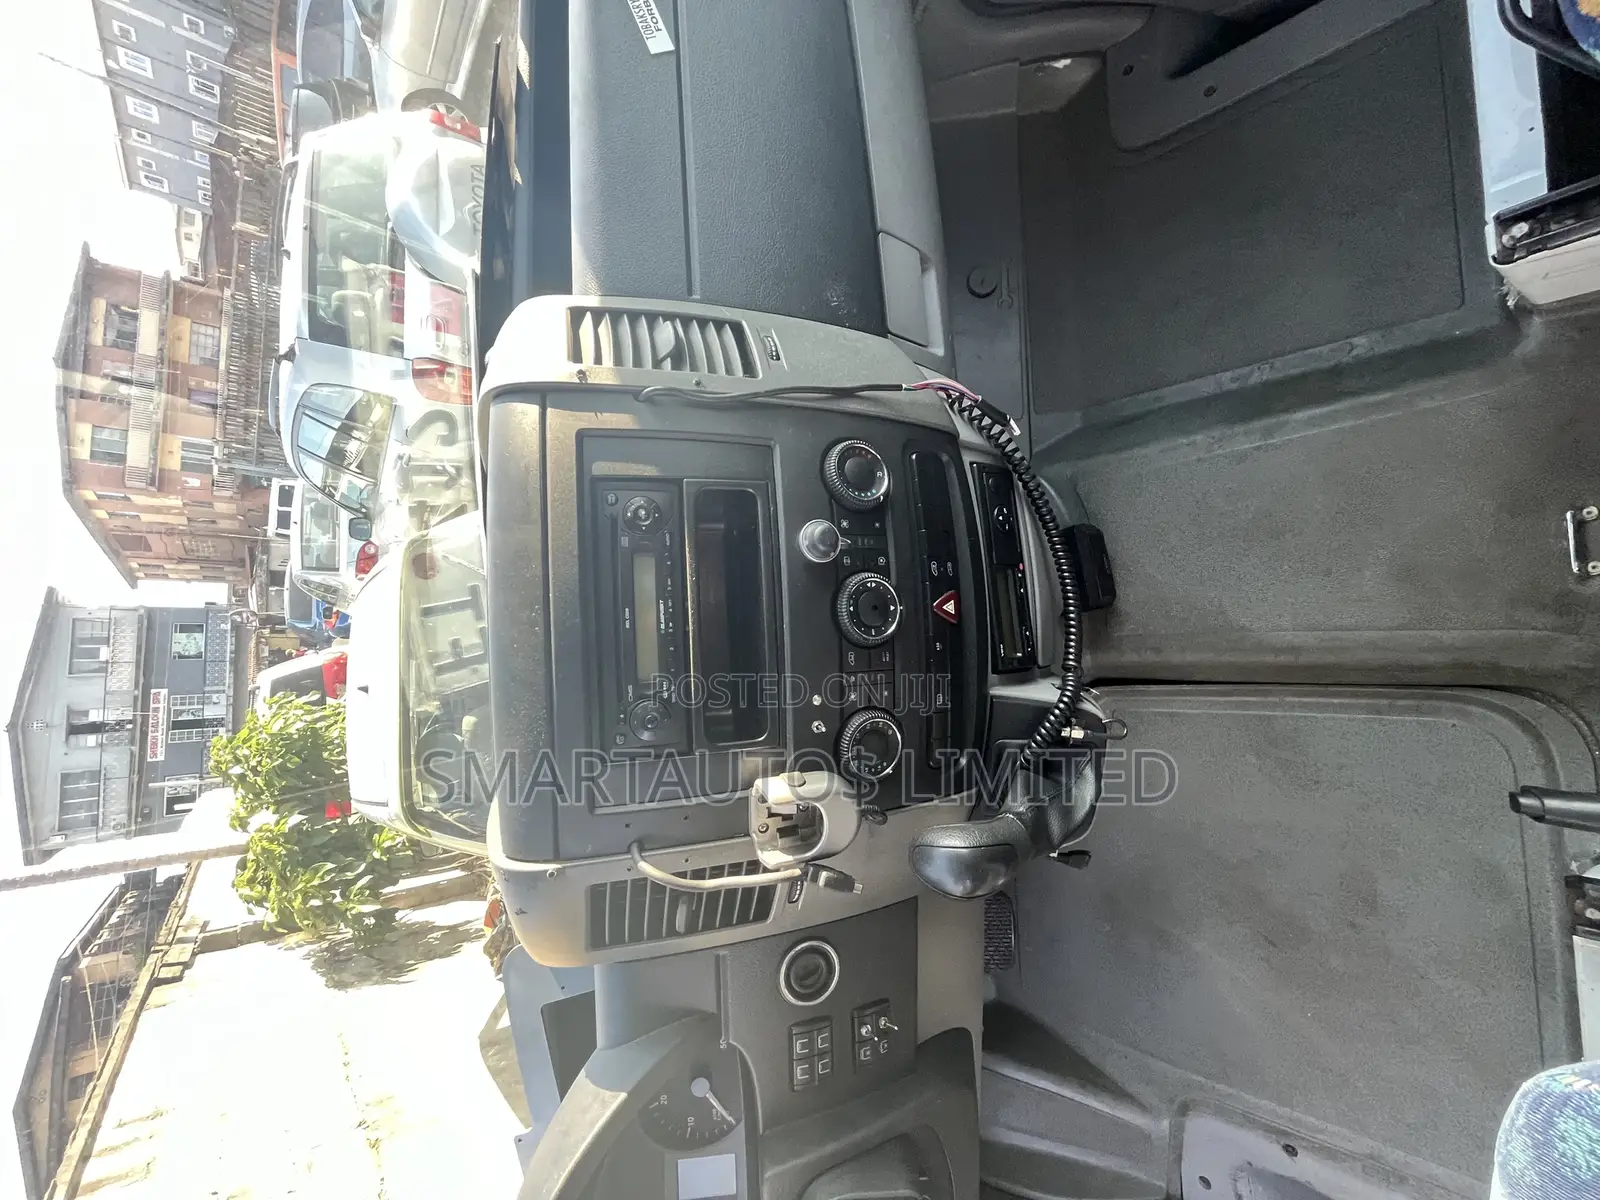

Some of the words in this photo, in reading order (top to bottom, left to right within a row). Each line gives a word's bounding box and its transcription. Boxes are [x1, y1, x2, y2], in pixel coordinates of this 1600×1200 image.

[152, 691, 161, 705] SPA
[660, 1094, 668, 1105] 20
[687, 1116, 695, 1127] 10
